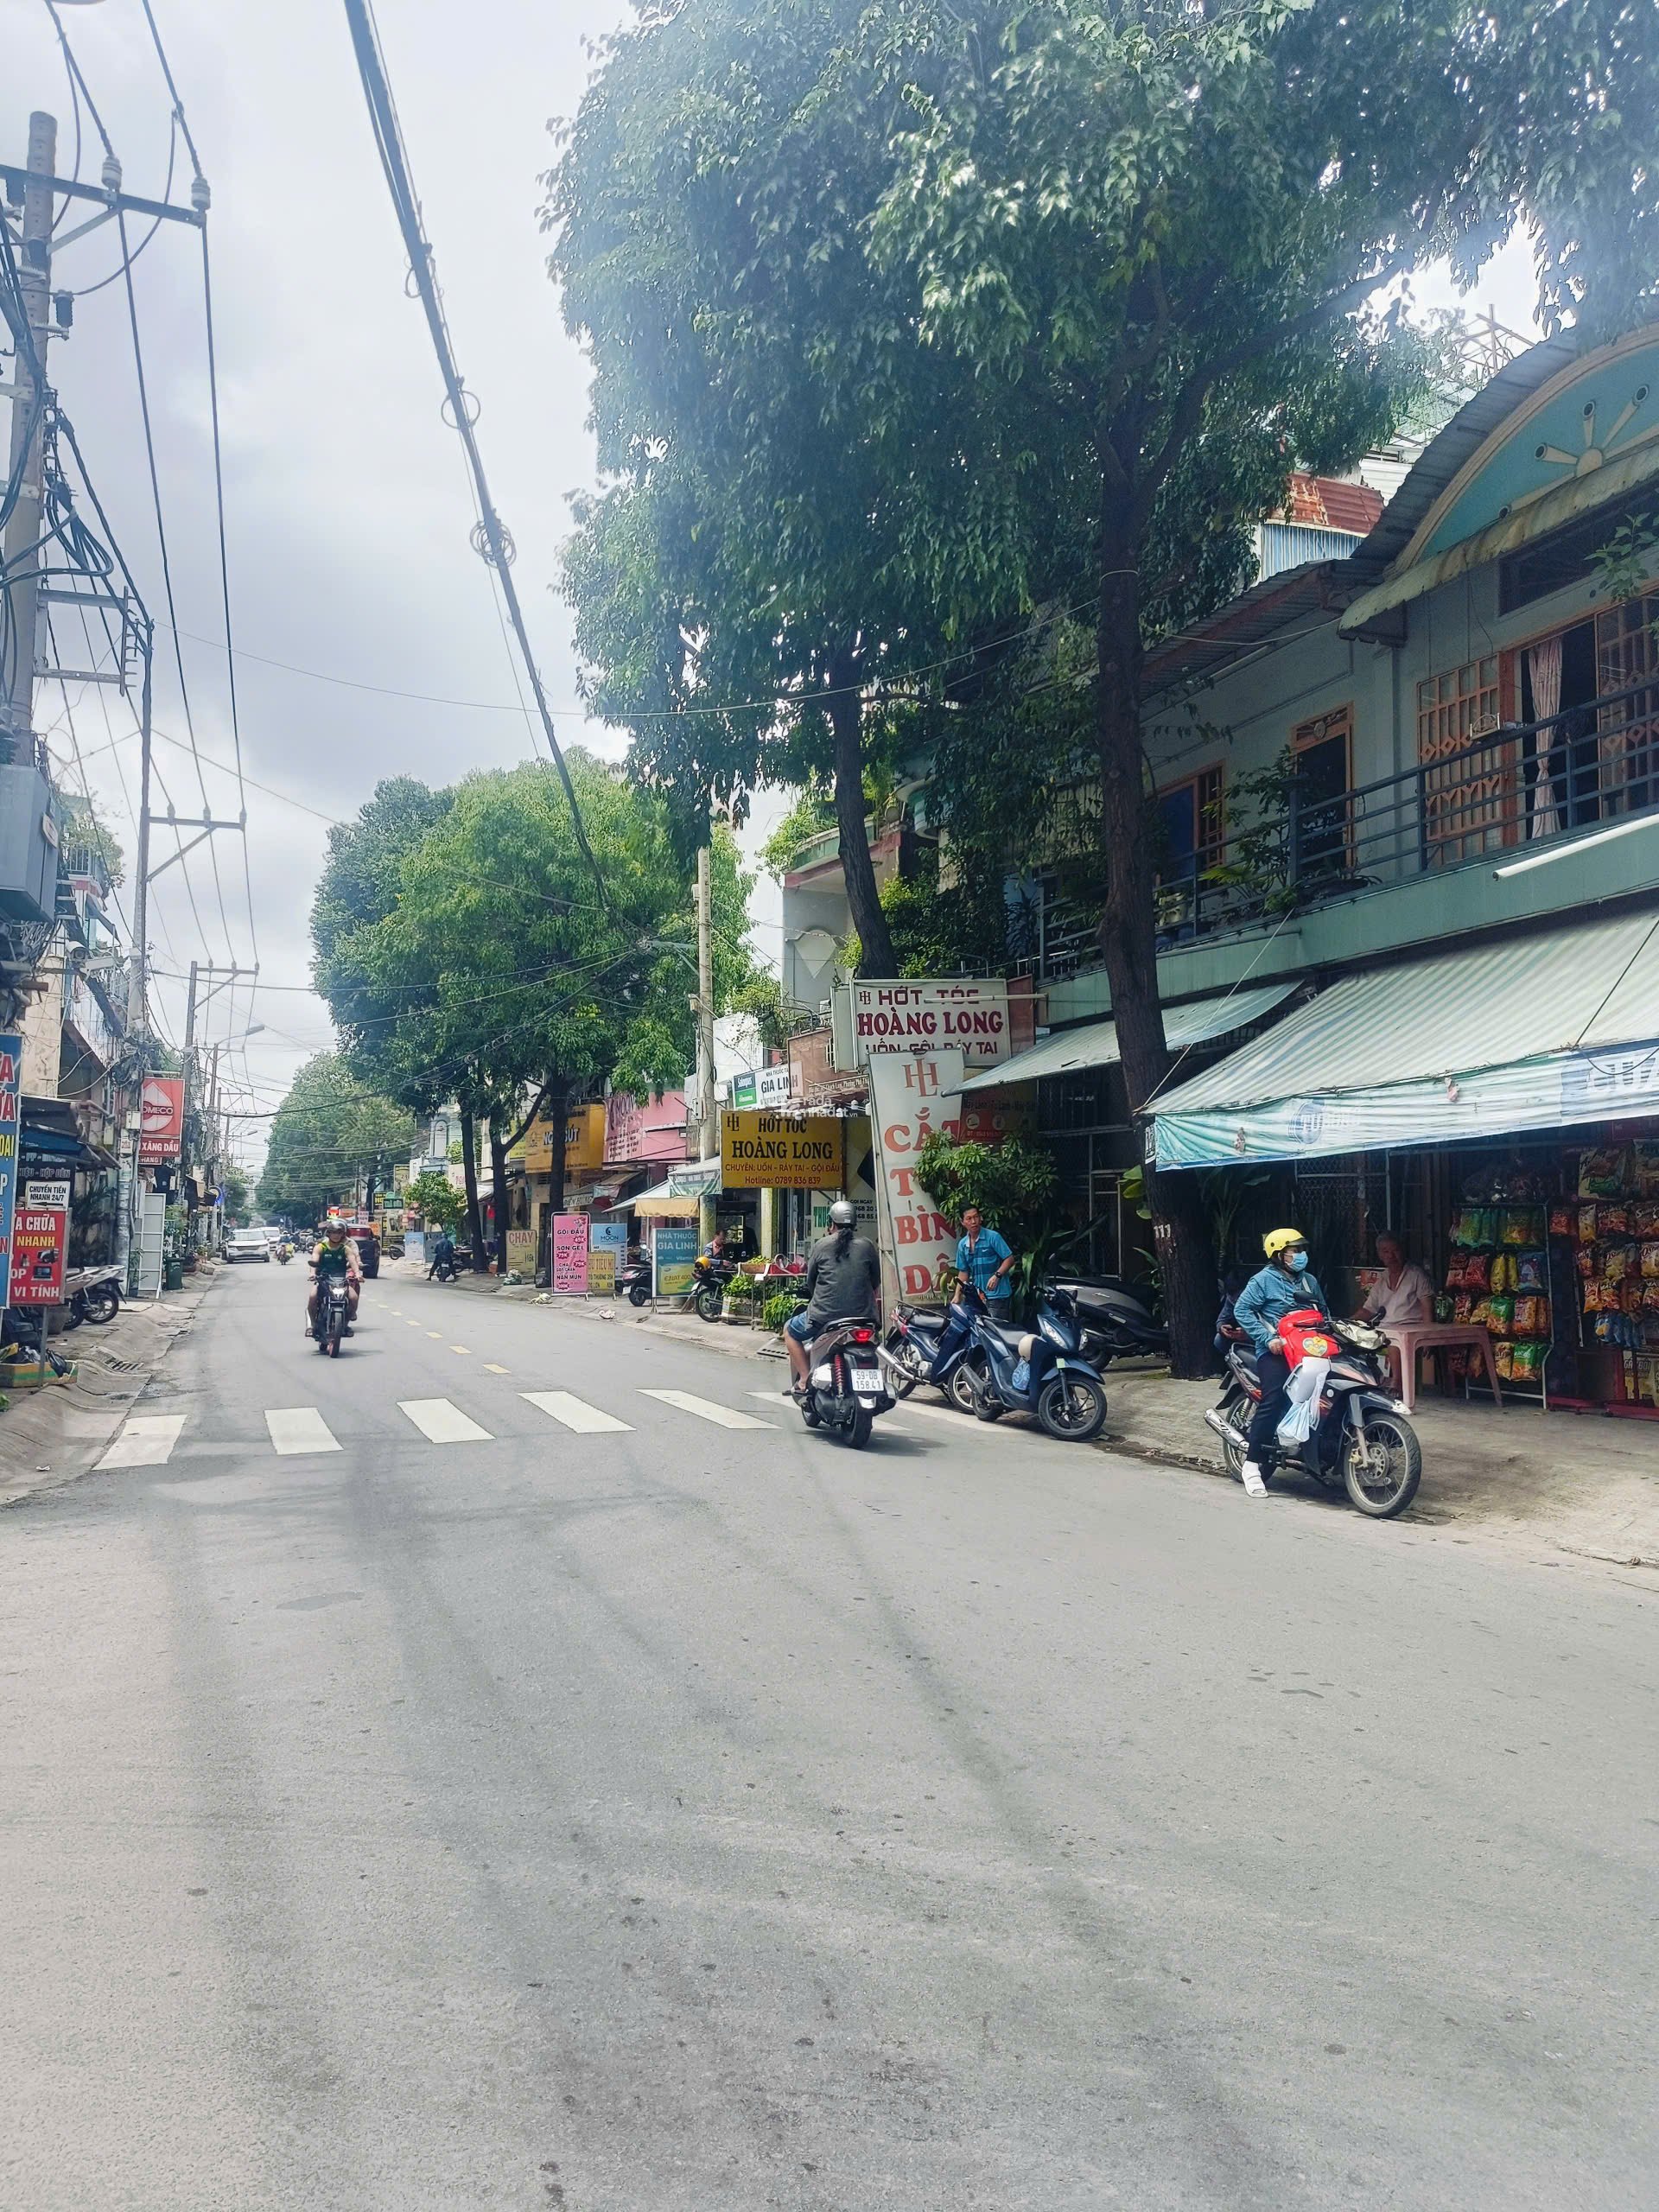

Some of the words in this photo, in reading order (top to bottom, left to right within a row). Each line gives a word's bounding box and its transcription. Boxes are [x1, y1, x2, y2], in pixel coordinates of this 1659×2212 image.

[857, 1007, 938, 1036] HOÀNG
[943, 1011, 1003, 1034] LONG
[976, 1042, 998, 1054] TAI
[761, 1080, 775, 1094] GIA
[778, 1075, 798, 1090] LINH
[142, 1141, 162, 1152] XĂNG
[163, 1140, 179, 1152] DẦU
[732, 1136, 787, 1159] HOÀNG
[792, 1141, 833, 1159] LONG
[757, 1161, 772, 1172] UỐN
[810, 1162, 825, 1173] GỘI
[825, 1162, 840, 1172] ĐẦU
[26, 1214, 56, 1231] CHỮA
[894, 1205, 957, 1244] BÌN
[509, 1231, 534, 1244] CHAY
[673, 1230, 697, 1239] THUỐC
[17, 1236, 55, 1247] NHANH
[14, 1287, 26, 1296] VI
[30, 1284, 60, 1297] TÍNH
[856, 1381, 880, 1389] 158.41
